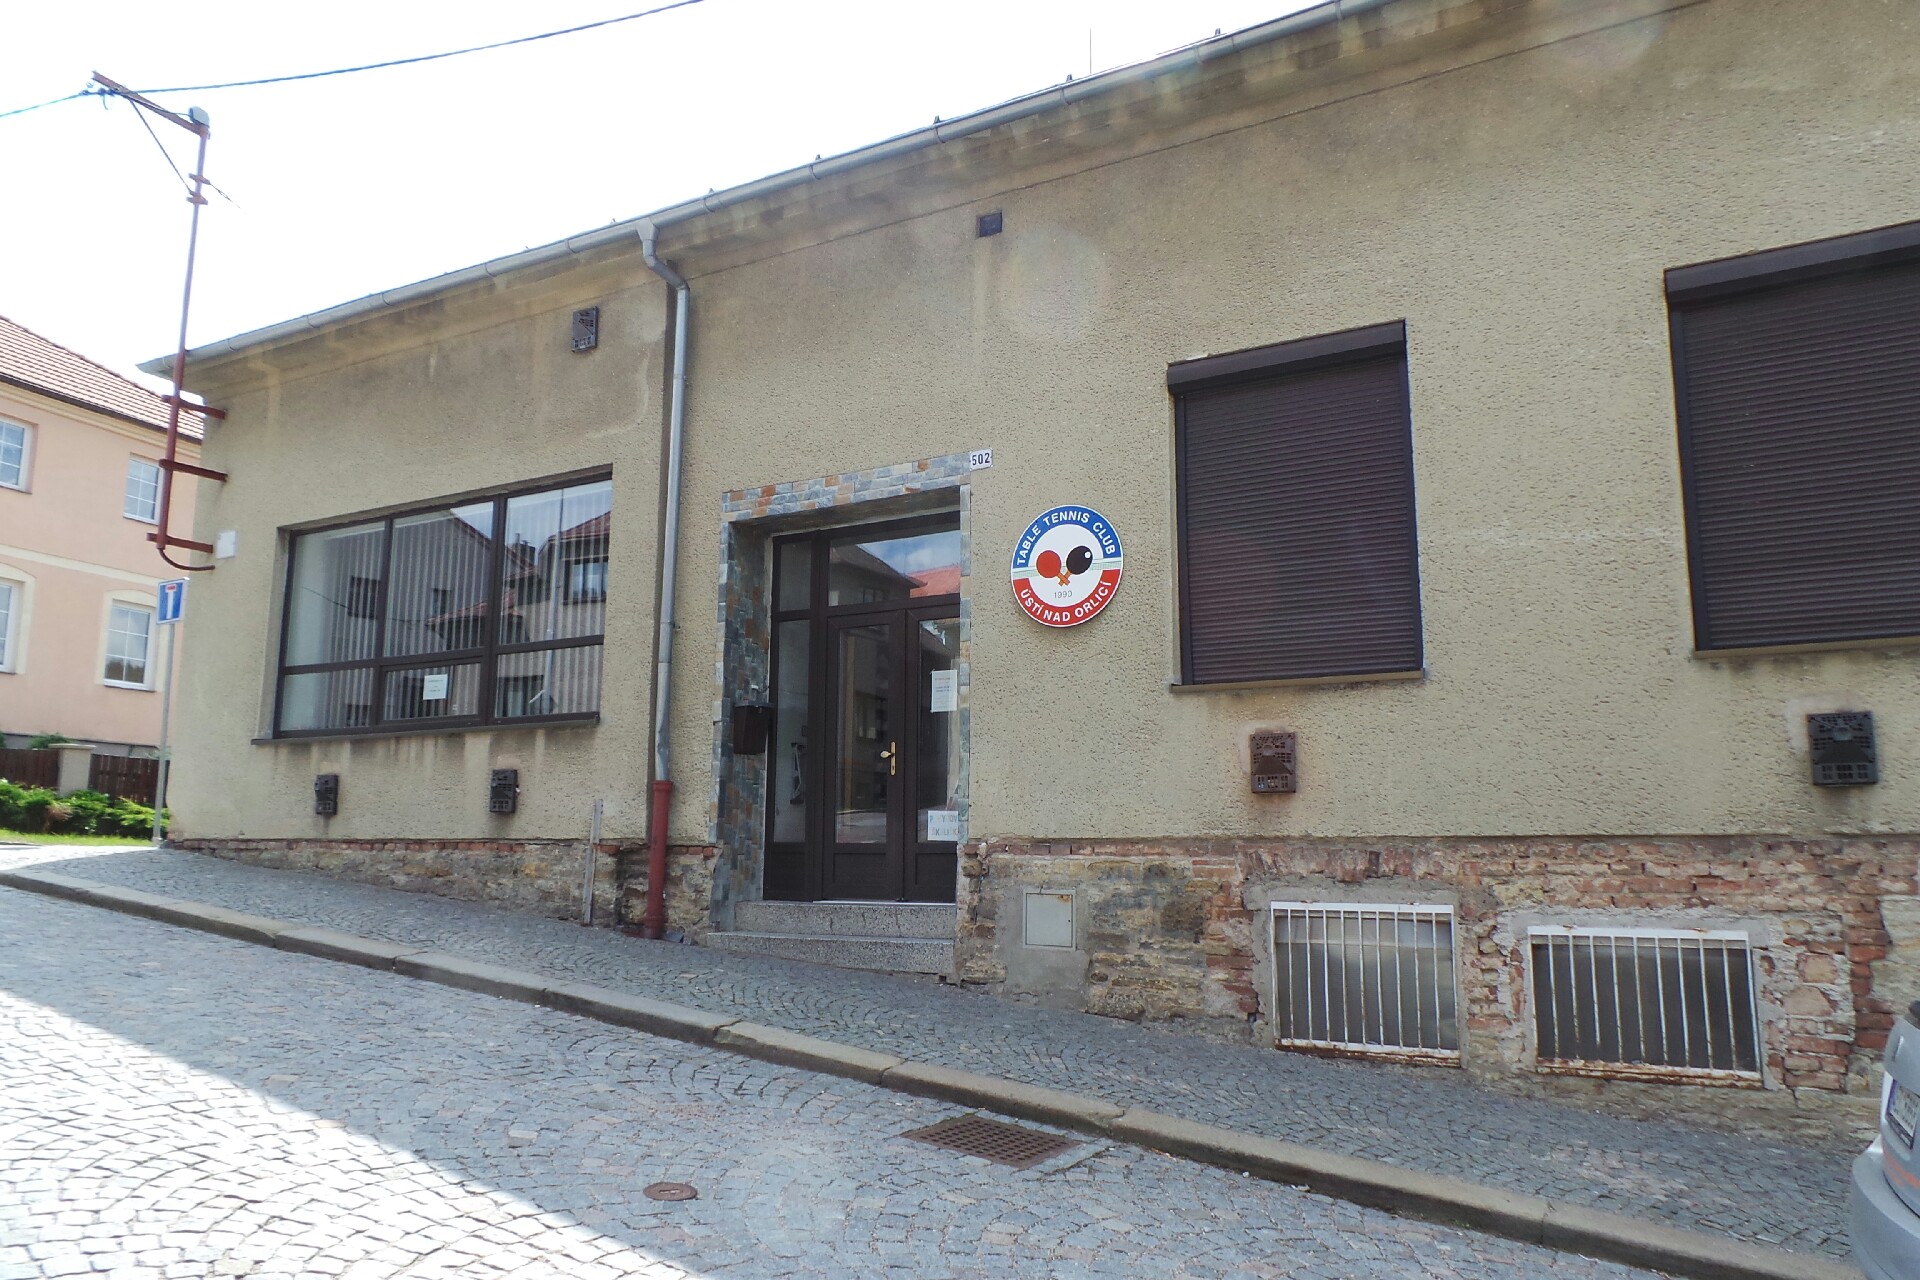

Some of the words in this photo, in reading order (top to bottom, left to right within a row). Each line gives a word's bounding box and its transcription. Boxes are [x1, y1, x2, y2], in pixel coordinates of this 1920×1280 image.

[972, 453, 990, 465] 502
[1017, 525, 1041, 565] TABLE
[1043, 511, 1090, 526] TENNIS
[1093, 522, 1116, 554] CLUB
[1020, 588, 1044, 616] ÚSTÍ
[1043, 609, 1071, 622] NAD
[1074, 580, 1112, 617] ORLICÍ
[1054, 590, 1073, 599] 1990
